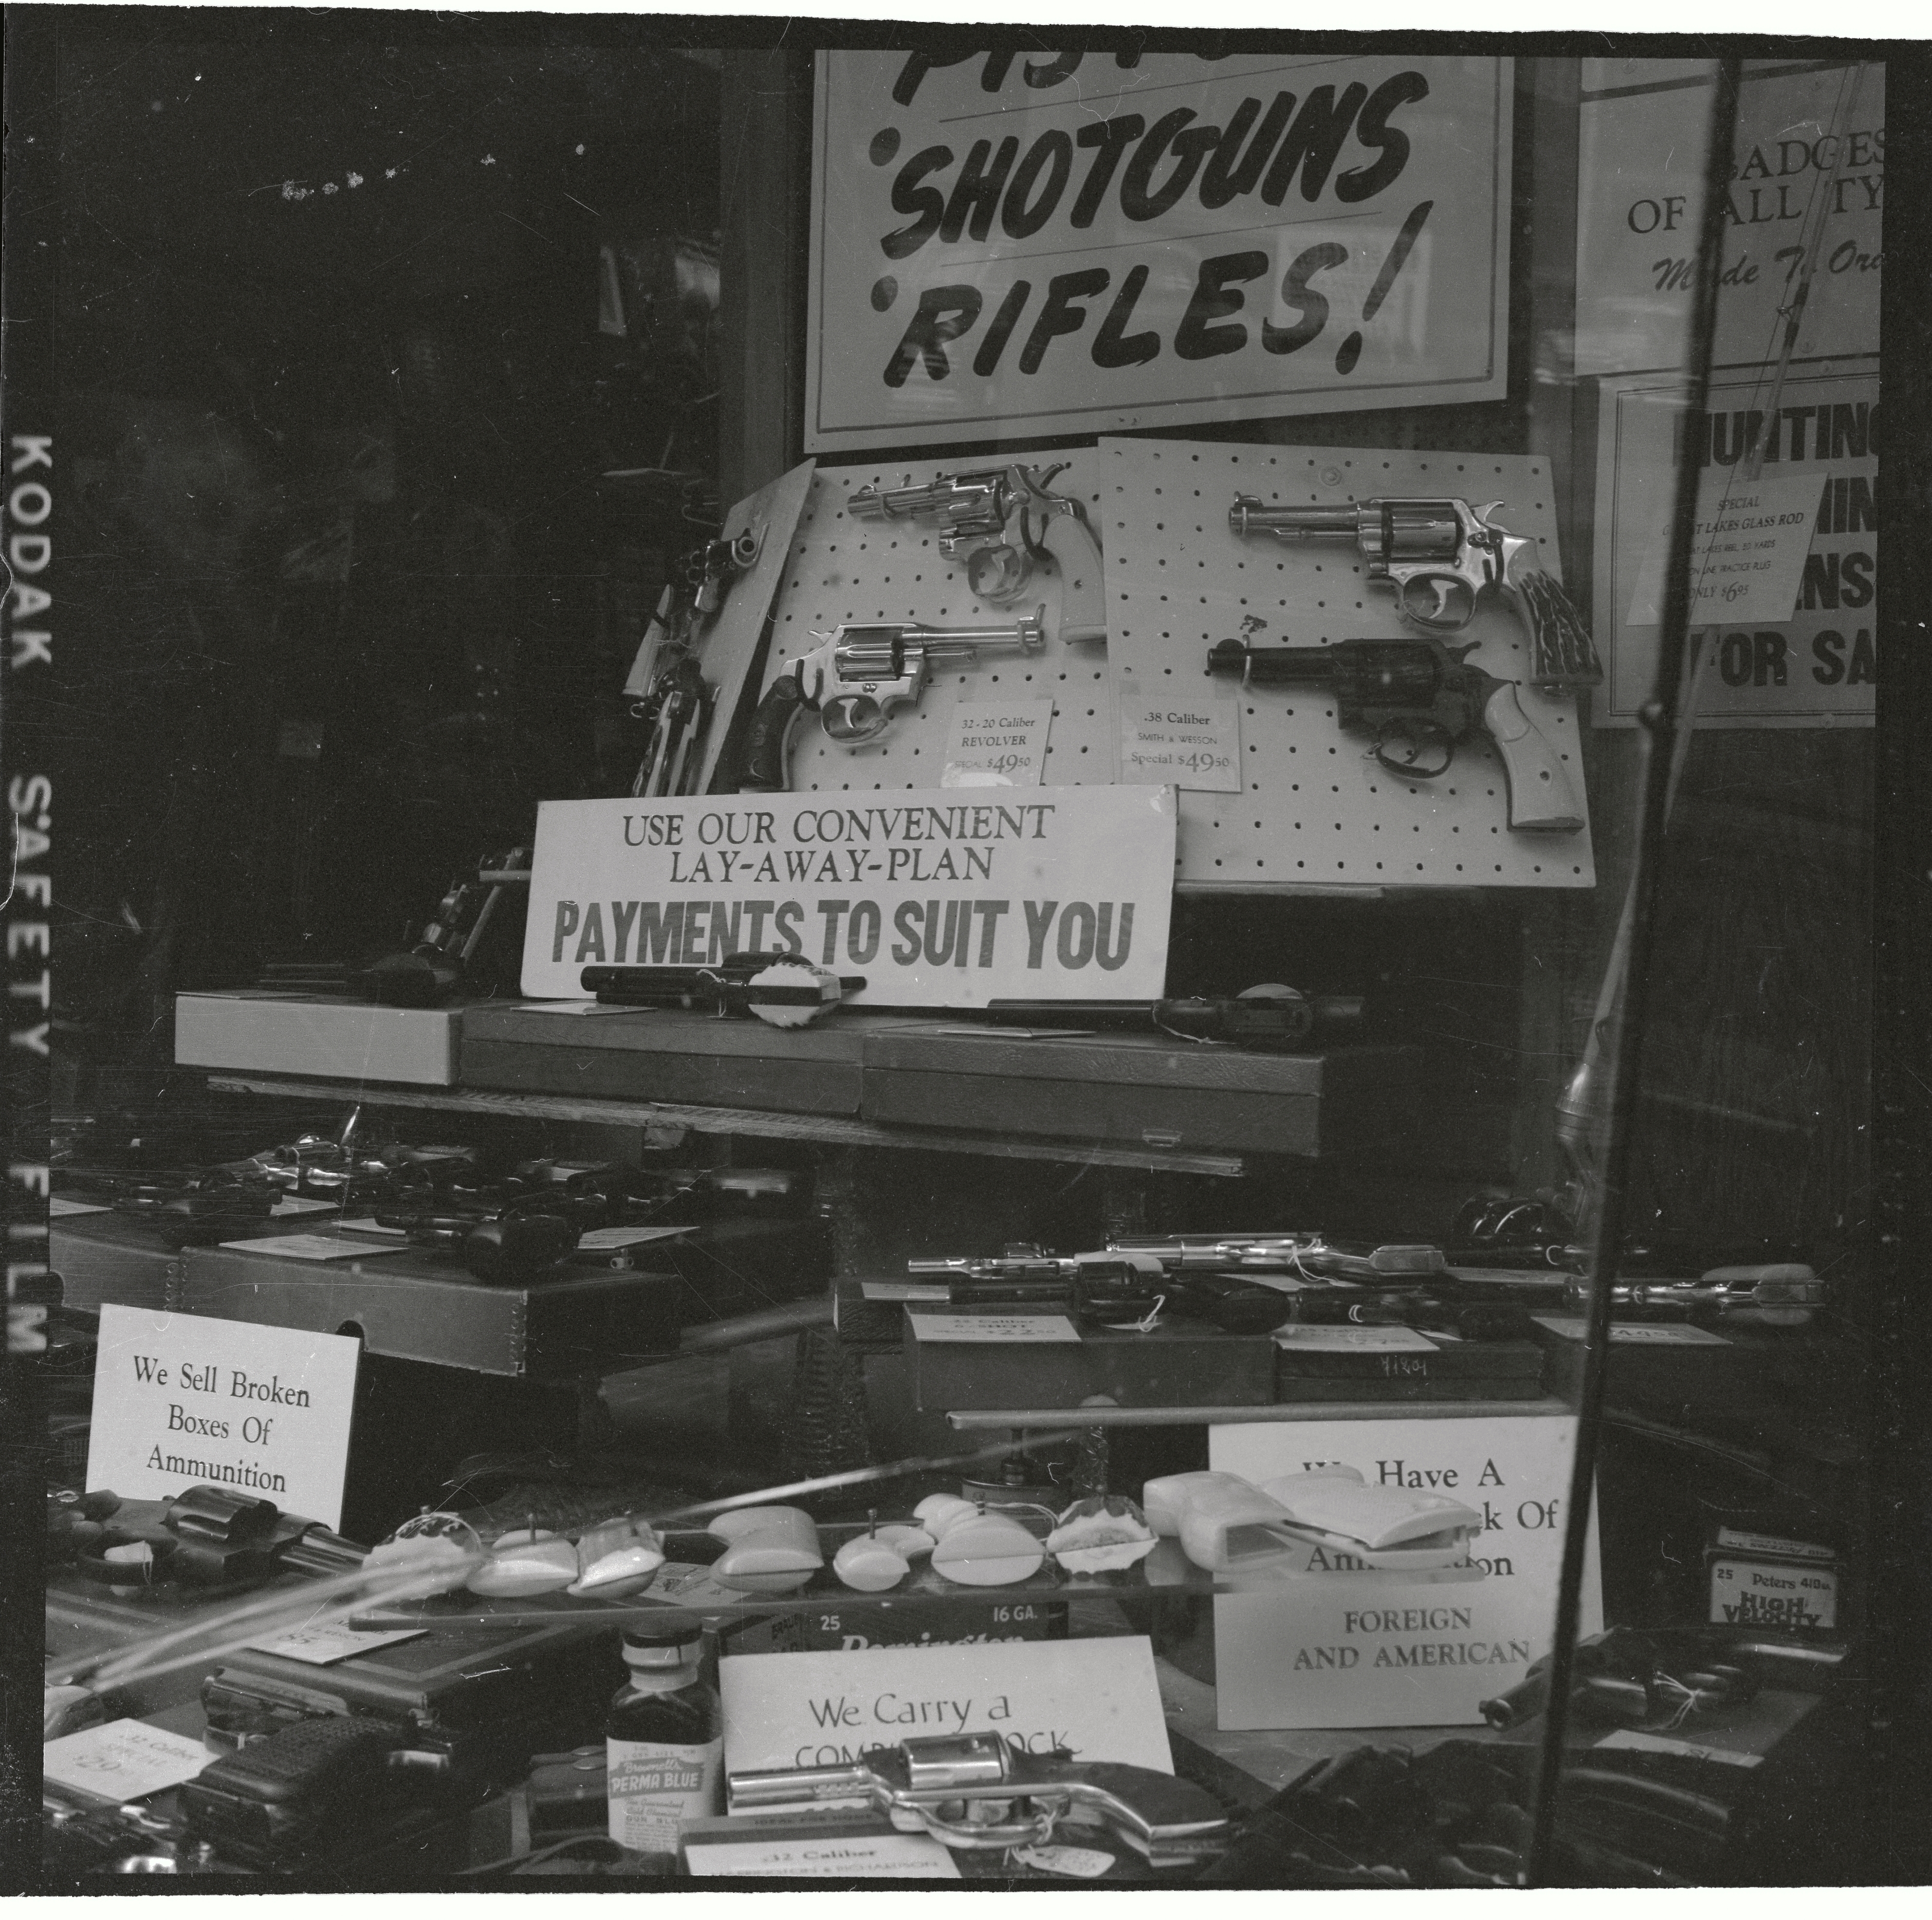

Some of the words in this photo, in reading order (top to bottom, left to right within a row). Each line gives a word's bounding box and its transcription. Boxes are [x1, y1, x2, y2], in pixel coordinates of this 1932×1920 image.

[880, 70, 1430, 260] SHOTGUNS
[1627, 196, 1687, 234] OF
[1652, 255, 1759, 292] Mde
[883, 199, 1434, 388] RIFLES!
[1673, 402, 1879, 468] HUNTIN
[1741, 515, 1776, 530] GLASS
[1778, 512, 1804, 526] ROD
[10, 436, 53, 671] KODAK
[998, 717, 1035, 728] Caliber
[1144, 712, 1162, 722] .38
[1167, 712, 1211, 725] Caliber
[961, 735, 1027, 747] REVOLVER
[1138, 732, 1164, 742] SMITH
[1178, 735, 1218, 745] WESSON
[1131, 751, 1172, 765] Special
[621, 812, 685, 848] USE
[697, 810, 777, 846] OUR
[791, 804, 1056, 845] CONVENIENT
[669, 845, 995, 884] LAY-AWAY-PLAN
[552, 898, 807, 965] PAYMENTS
[817, 898, 882, 967] TO
[891, 898, 1010, 969] SUIT
[1022, 899, 1136, 972] YOU
[7, 1164, 49, 1352] FILM
[133, 1354, 168, 1386] We
[180, 1362, 218, 1393] Sell
[230, 1370, 311, 1408] Broken
[167, 1403, 230, 1440] Boxes
[242, 1416, 274, 1446] Of
[146, 1443, 287, 1494] Ammunition
[1375, 1460, 1459, 1489] Have
[1477, 1457, 1506, 1487] A
[1516, 1499, 1560, 1531] Of
[1717, 1568, 1733, 1580] 25
[1752, 1573, 1796, 1590] Peters
[821, 1615, 841, 1631] 25
[993, 1607, 1009, 1622] 16
[1013, 1605, 1038, 1621] GA.
[1721, 1604, 1823, 1627] VELOCITY
[1741, 1591, 1805, 1614] HIGH
[1343, 1607, 1472, 1634] FOREIGN
[1292, 1646, 1359, 1671] AND
[1373, 1640, 1531, 1668] AMERICAN
[809, 1697, 862, 1728] We
[874, 1693, 972, 1737] Carry
[988, 1695, 1012, 1720] a
[611, 1774, 660, 1792] PERMA
[663, 1772, 699, 1788] BLUE
